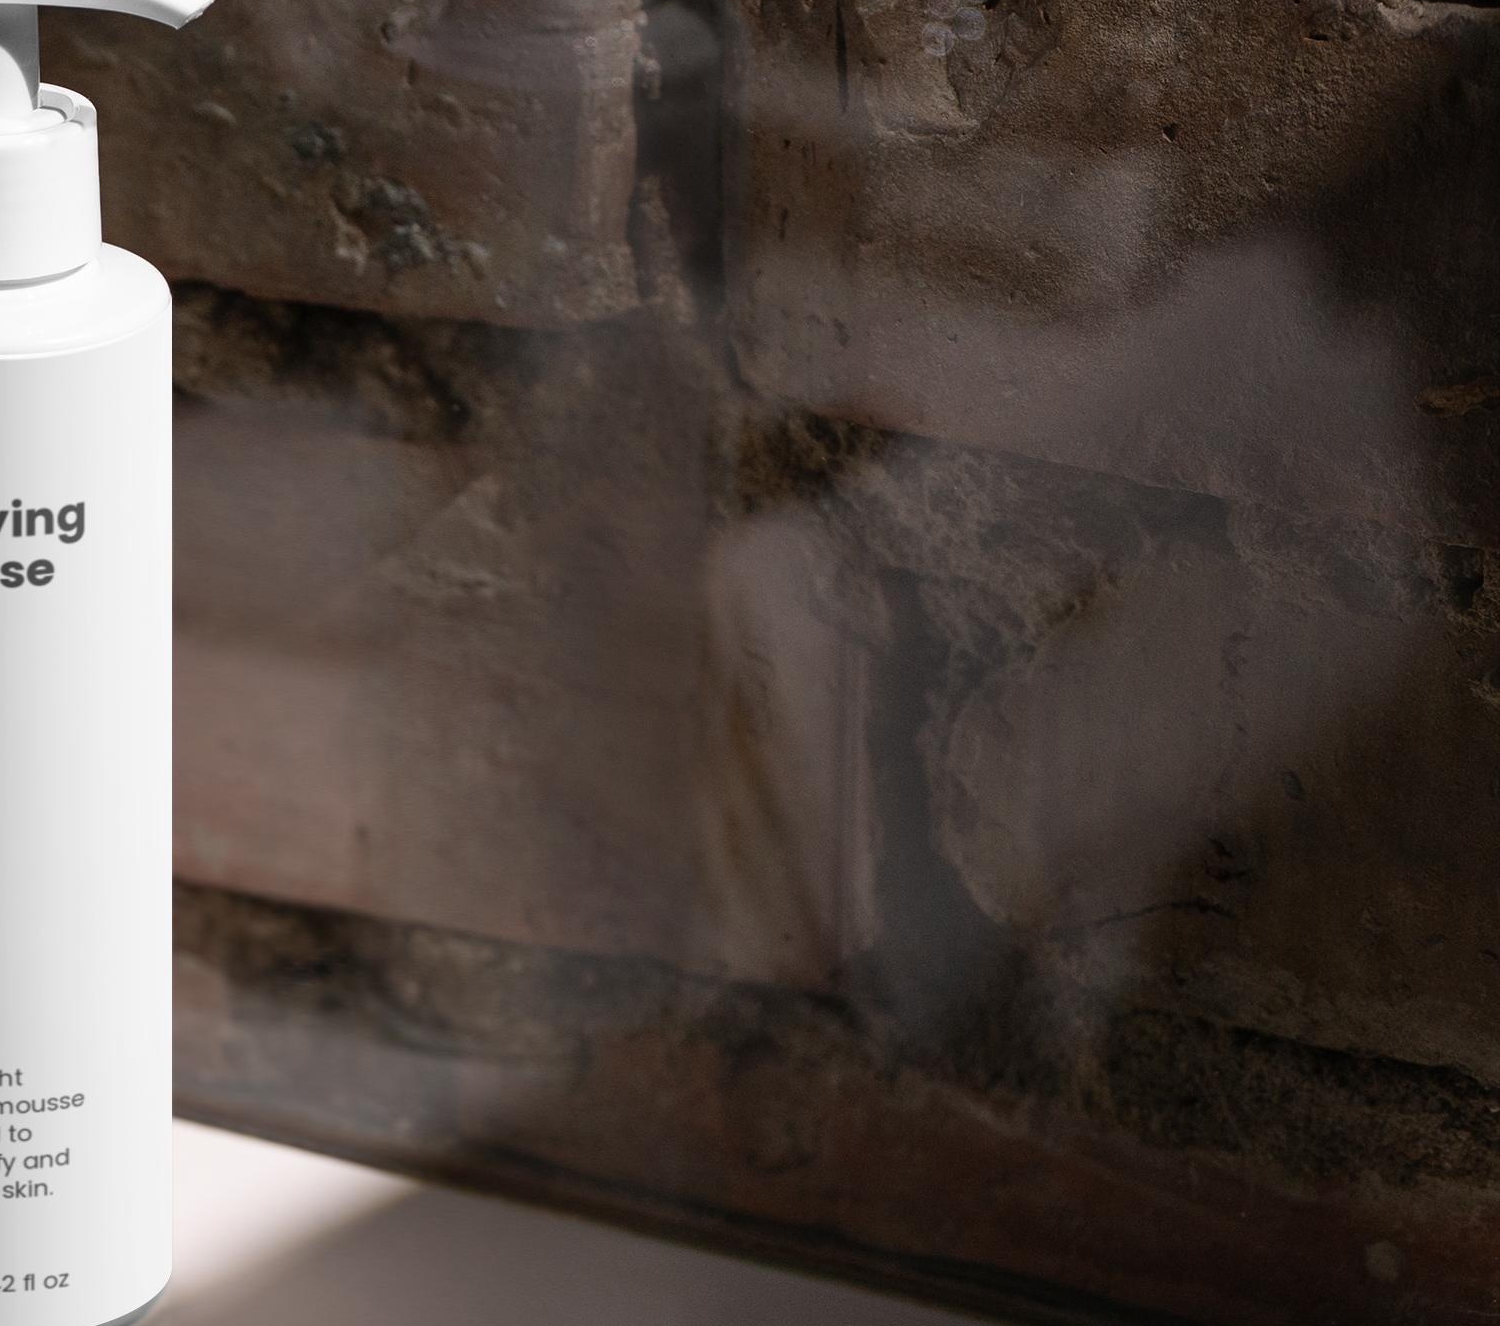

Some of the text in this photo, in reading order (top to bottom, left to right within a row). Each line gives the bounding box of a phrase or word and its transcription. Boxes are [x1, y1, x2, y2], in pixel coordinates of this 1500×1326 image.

[8, 1125, 32, 1143] to
[23, 1148, 70, 1170] and
[2, 1180, 53, 1199] skin.
[23, 1273, 35, 1291] fl
[43, 1273, 69, 1289] oz
